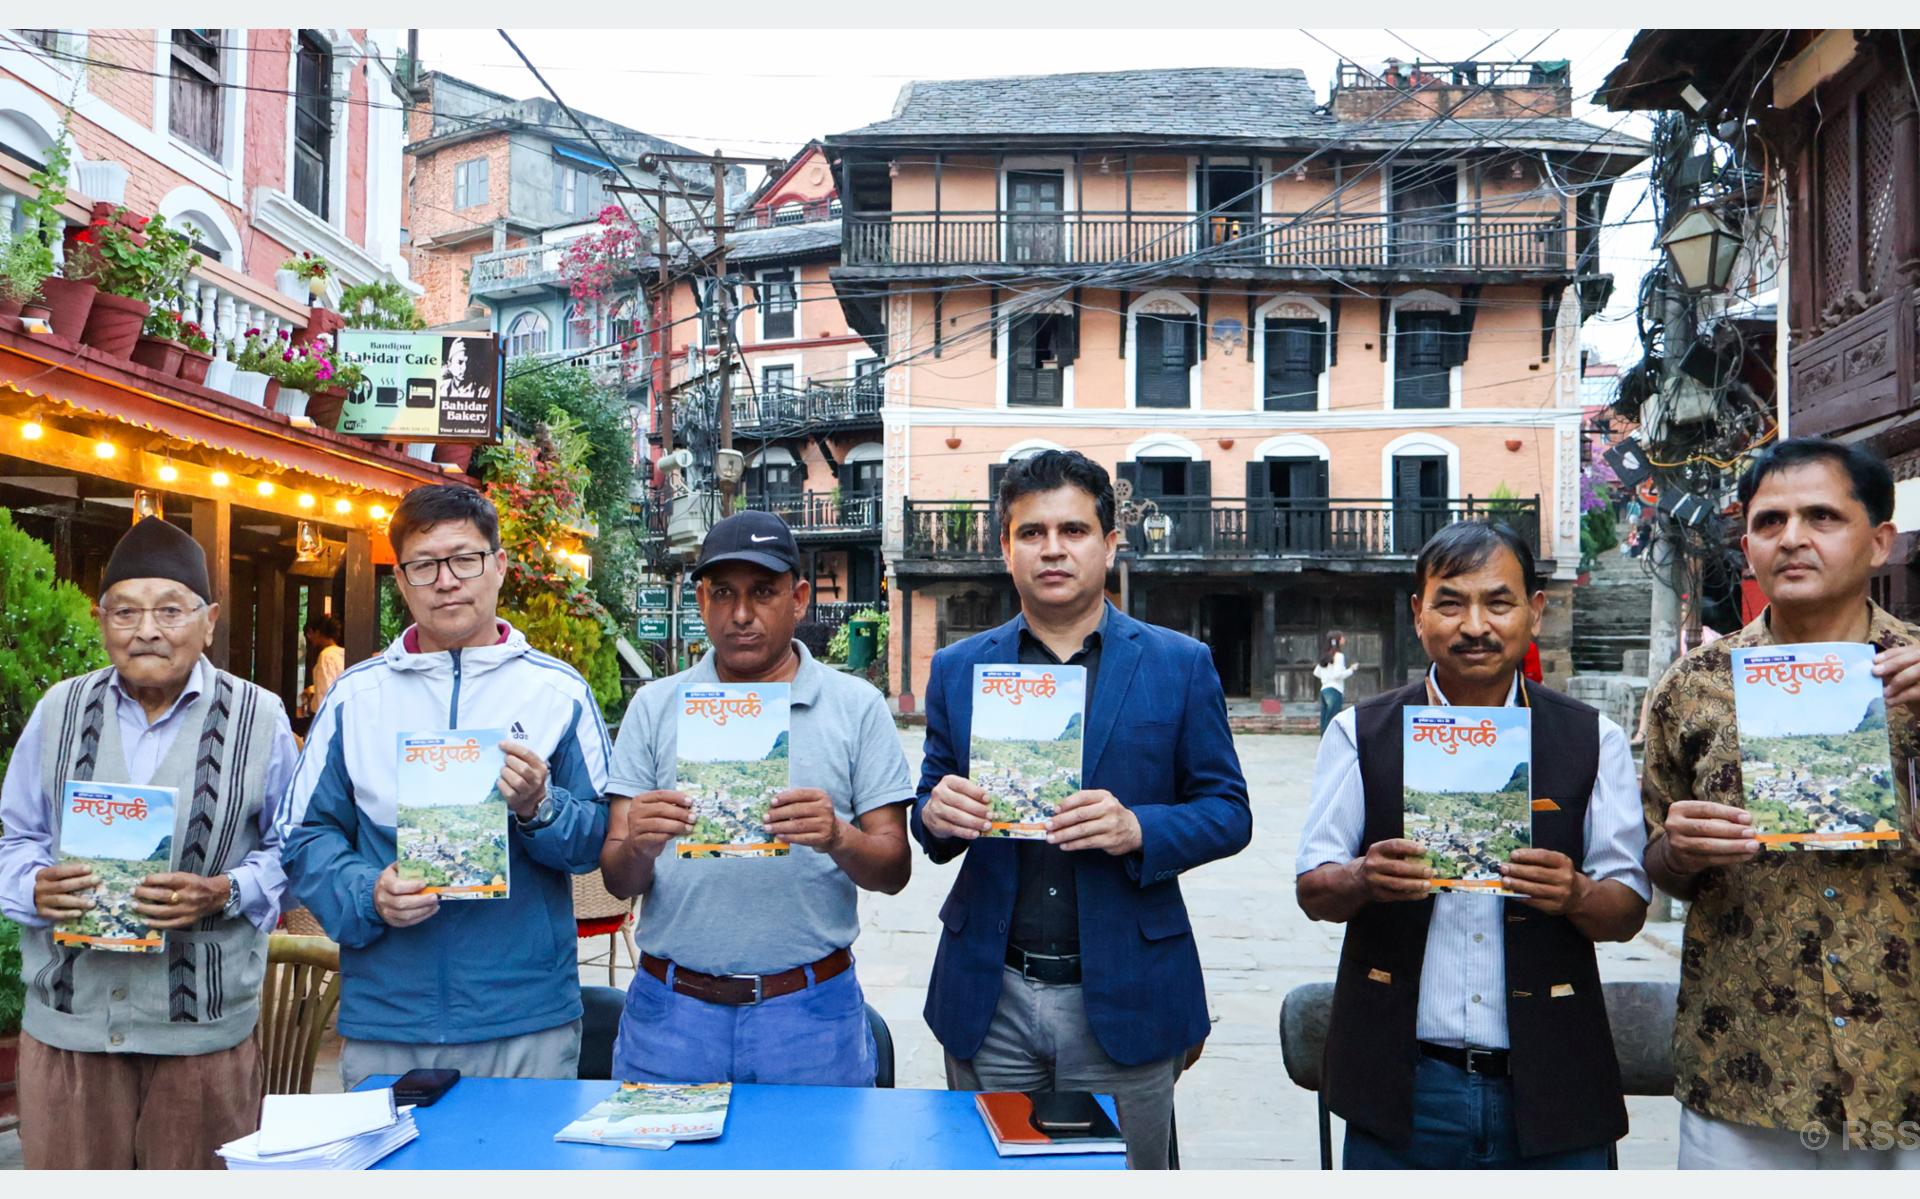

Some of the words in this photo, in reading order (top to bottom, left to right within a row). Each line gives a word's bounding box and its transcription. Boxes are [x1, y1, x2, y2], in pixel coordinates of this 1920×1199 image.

[370, 342, 412, 351] Bandipur
[405, 353, 438, 366] Cafe
[441, 401, 488, 412] Bahidar
[447, 411, 488, 424] Bakery
[981, 673, 1057, 705] मधुपर्क
[1745, 654, 1845, 695] मधुपर्क
[685, 692, 762, 726] मधुपर्क
[1413, 719, 1497, 755] मधुपर्क
[405, 739, 480, 772] मधुपर्क
[72, 798, 148, 826] मधुपर्क
